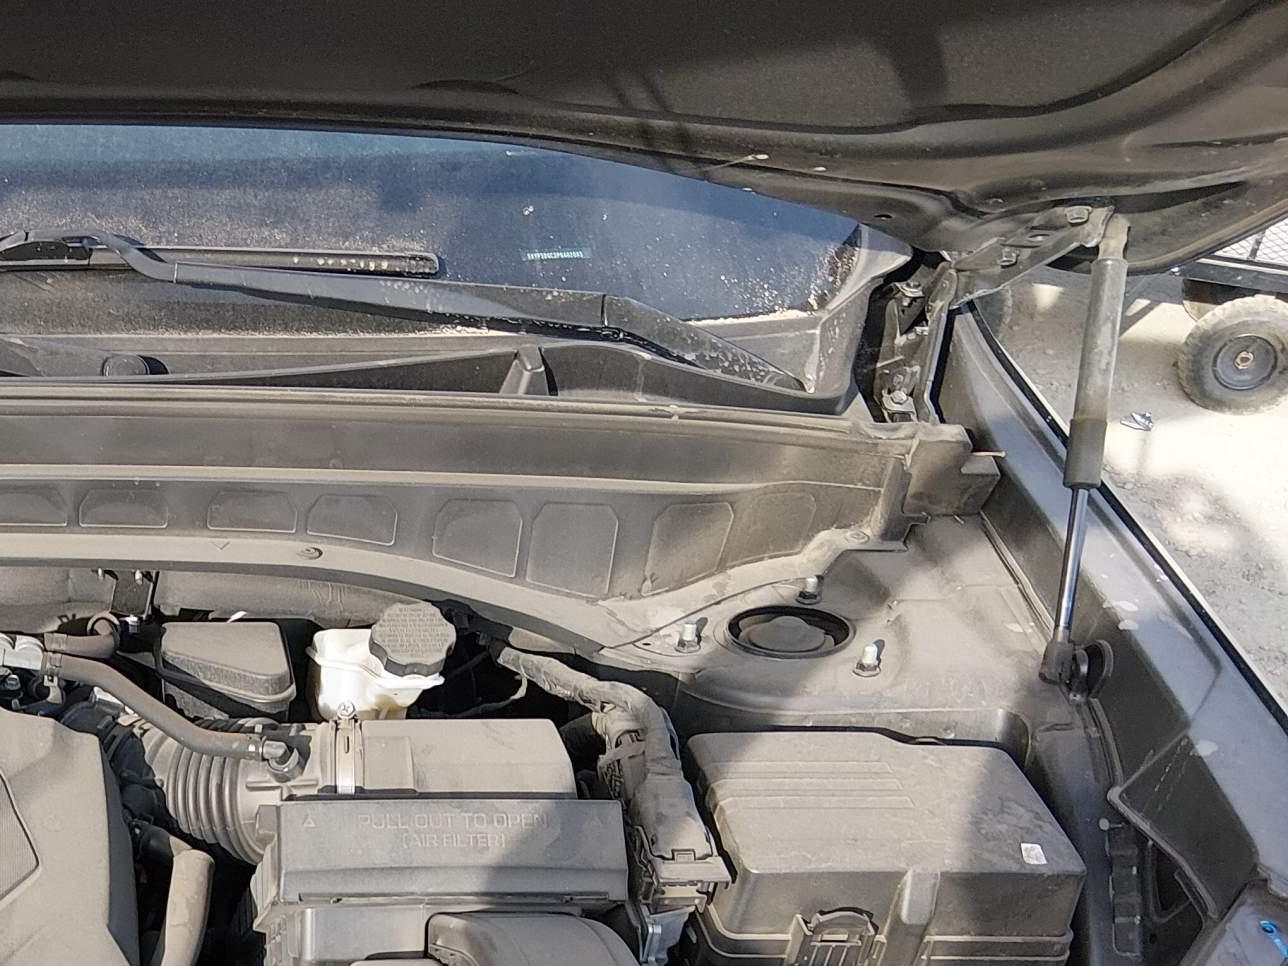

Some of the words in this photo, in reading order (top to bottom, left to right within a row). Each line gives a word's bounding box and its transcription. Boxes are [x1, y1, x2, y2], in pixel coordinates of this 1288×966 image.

[358, 813, 409, 830] PULL
[414, 812, 456, 829] OUT
[461, 812, 487, 829] TO
[494, 812, 549, 830] OPEN
